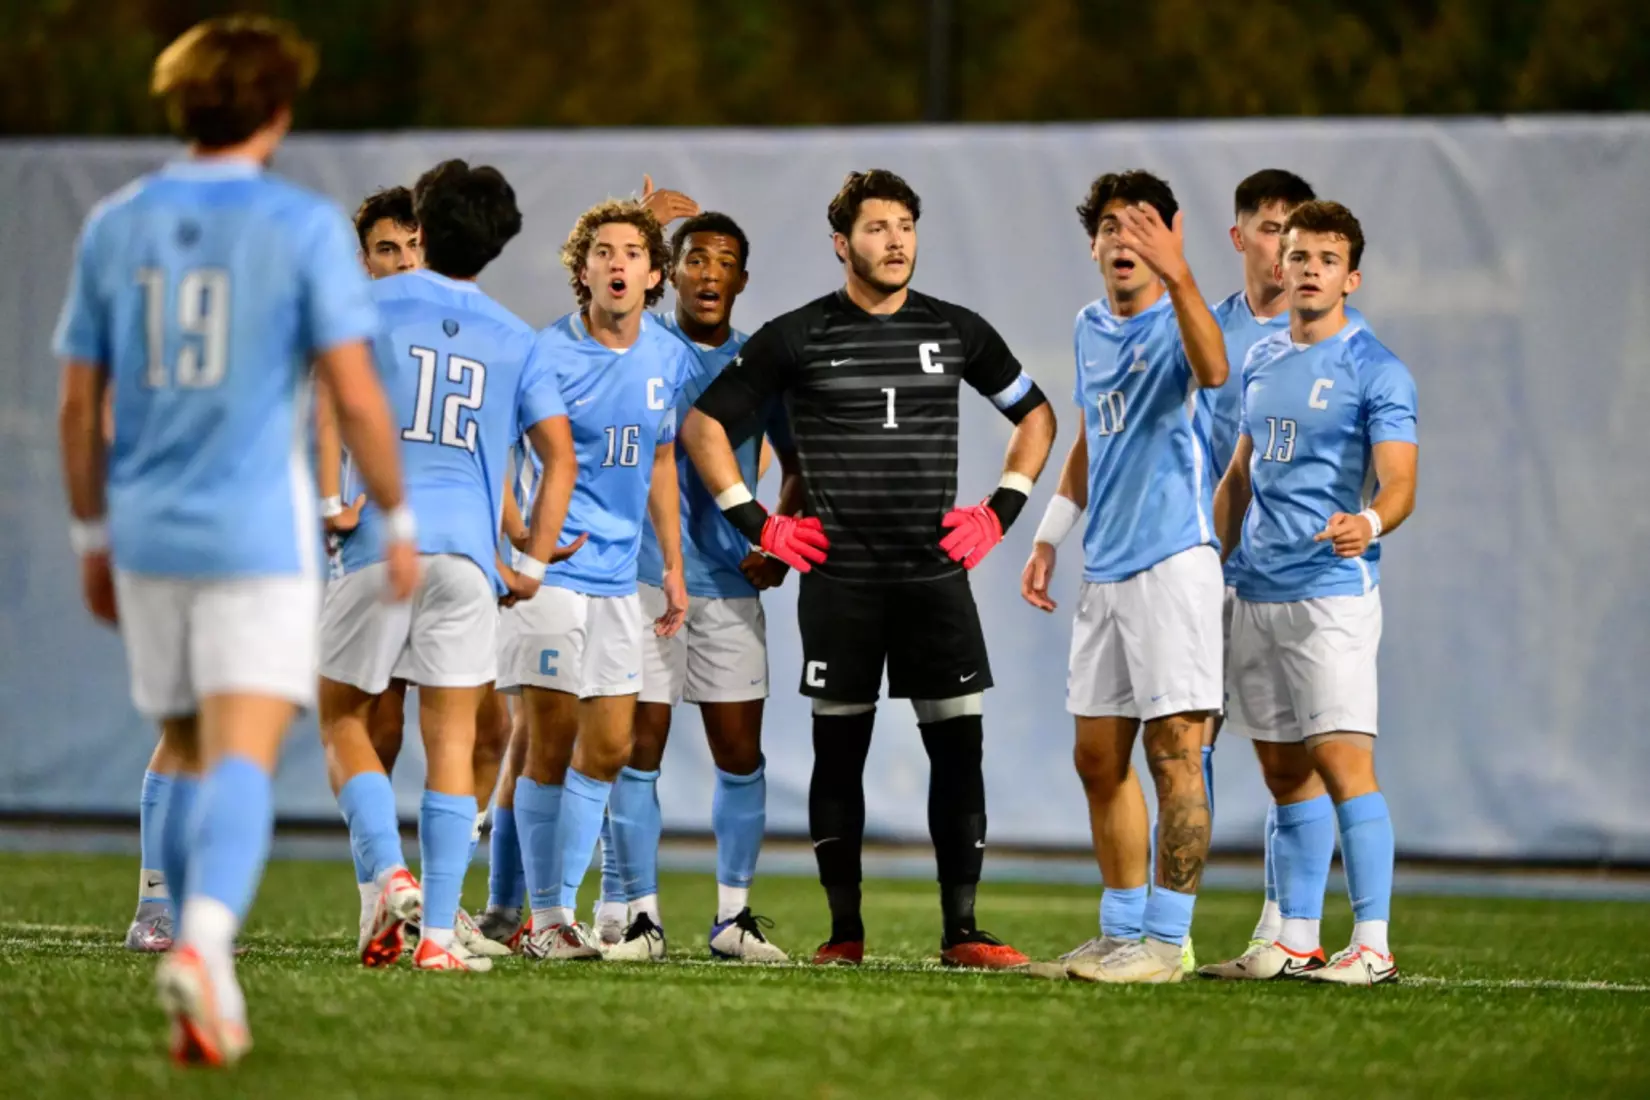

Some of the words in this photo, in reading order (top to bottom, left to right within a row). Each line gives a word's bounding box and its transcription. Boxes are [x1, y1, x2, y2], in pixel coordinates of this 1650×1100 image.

[134, 265, 232, 388] 19
[919, 342, 944, 373] C
[400, 344, 487, 456] 12
[646, 376, 665, 411] C
[880, 387, 899, 430] 1
[1308, 377, 1336, 410] C
[600, 424, 641, 468] 16
[1262, 416, 1298, 463] 13
[538, 648, 559, 677] C
[806, 659, 828, 689] C
